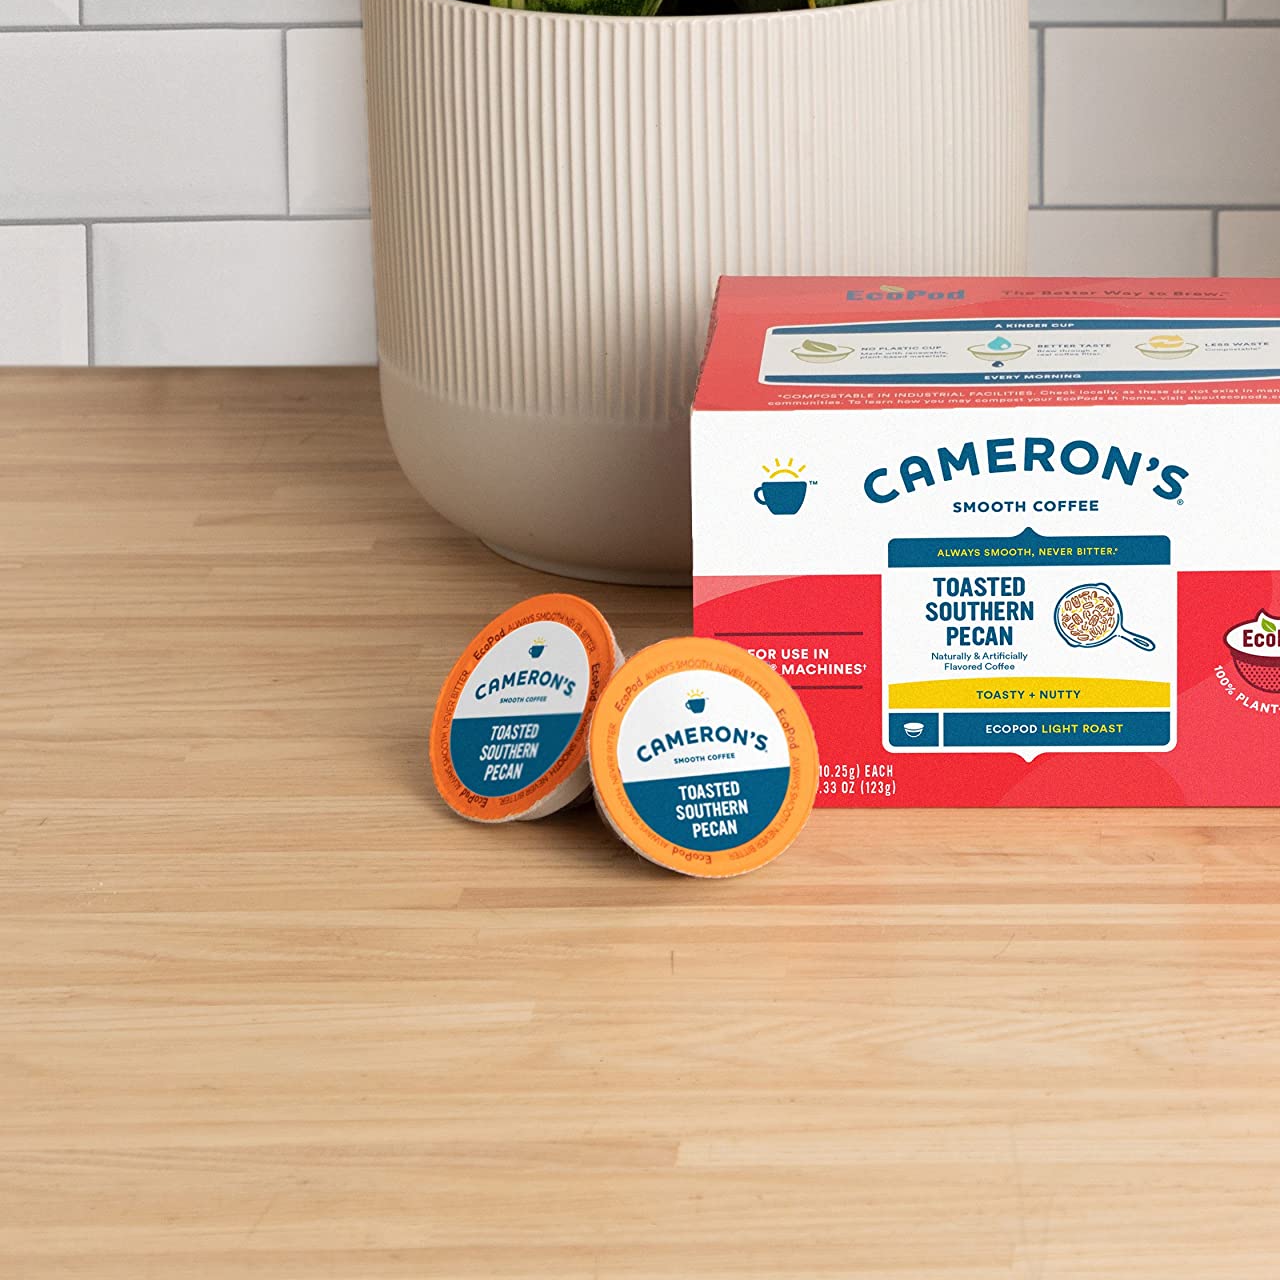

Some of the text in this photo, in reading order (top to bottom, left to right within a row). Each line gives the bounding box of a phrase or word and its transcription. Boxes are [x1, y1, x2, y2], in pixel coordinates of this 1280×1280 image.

[846, 289, 965, 301] EcoPod
[952, 499, 1099, 513] SMOOTH COFFEE
[937, 548, 981, 558] ALWAYS
[983, 547, 1036, 559] SMOOTH,
[1038, 547, 1073, 556] NEVER
[932, 576, 1026, 597] TOASTED
[925, 600, 1034, 622] SOUTHERN
[473, 625, 505, 661] EcoPod
[507, 613, 535, 633] ALWAYS
[946, 626, 1013, 646] PECAN
[781, 648, 809, 660] USE
[813, 648, 829, 660] IN
[931, 651, 1028, 662] Naturally & Artificially
[944, 661, 1015, 671] Flavored Coffee
[475, 669, 576, 700] CAMERON'S
[587, 661, 599, 701] EcoPod
[614, 676, 643, 712] EcoPod
[644, 661, 675, 682] ALWAYS
[1213, 665, 1237, 696] 100%
[525, 695, 548, 703] COFFEE
[976, 689, 1081, 700] TOASTY + NUTTY
[491, 723, 540, 740] TOASTED
[775, 707, 799, 749] EcoPod
[985, 723, 1124, 734] ECOPOD LIGHT ROAST
[480, 742, 540, 761] SOUTHERN
[636, 725, 768, 762] CAMERON'S
[674, 752, 736, 765] SMOOTH COFFEE
[484, 763, 524, 781] PECAN
[818, 763, 893, 780] 10.25g) EACH
[458, 787, 488, 807] EcoPod
[678, 780, 741, 801] TOASTED
[817, 780, 896, 797] .33 OZ (123g)
[675, 799, 749, 821] SOUTHERN
[692, 819, 738, 839] PECAN
[670, 846, 711, 863] EcoPod
